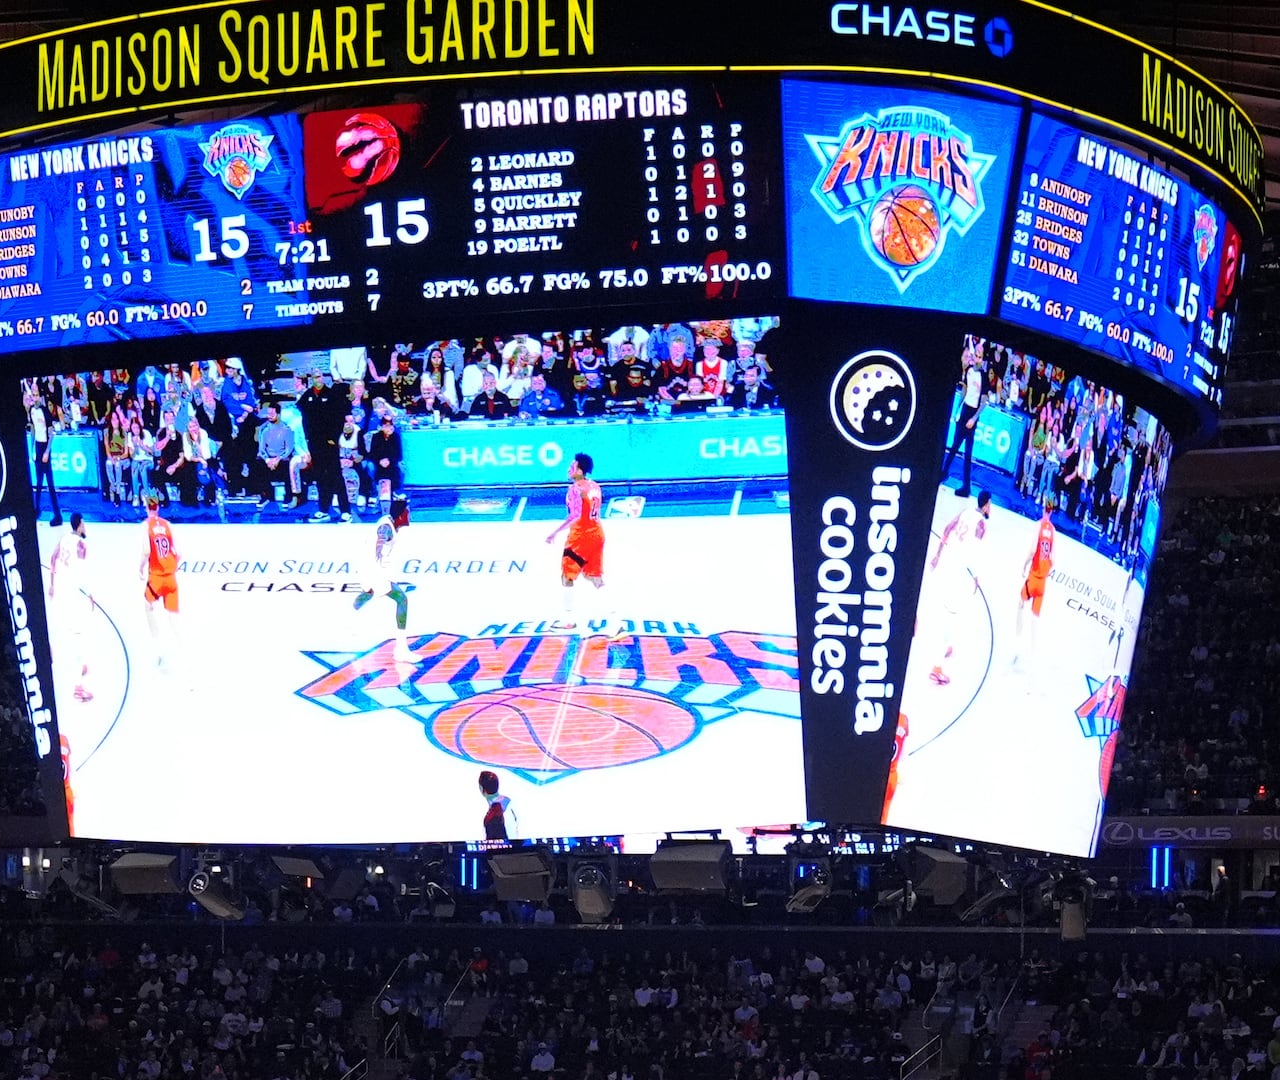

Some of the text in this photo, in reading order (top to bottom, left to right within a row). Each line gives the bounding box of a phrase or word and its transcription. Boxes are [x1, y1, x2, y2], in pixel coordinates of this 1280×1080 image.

[830, 3, 976, 47] CHASE
[37, 0, 595, 113] MADISON SQUARE GARDEN
[460, 88, 688, 130] TORONTO RAPTORS
[880, 112, 946, 134] NEW YORK
[1142, 52, 1224, 165] MADISON
[10, 137, 153, 182] NEW YORK KNICKS
[471, 151, 575, 172] 2 LEONARD
[820, 125, 978, 209] KNICKS
[1077, 136, 1179, 207] NEW YORK KNICKS
[472, 172, 563, 192] 4 BARNES
[474, 191, 582, 214] 5 QUICKLEY
[192, 213, 250, 262] 15
[288, 219, 312, 234] 1st
[364, 198, 429, 247] 15
[474, 213, 578, 234] 9 BARRETT
[274, 239, 331, 265] 7:21
[467, 235, 563, 256] 19 POELTL
[240, 268, 379, 295] 2 TEAM FOULS 2
[422, 261, 771, 299] 3PT% 66.7 FG% 75.0 FT% 100.0
[242, 294, 381, 320] 7 TIMEOUTS 7
[1175, 277, 1201, 322] 15
[16, 317, 44, 335] 66.7
[51, 313, 81, 330] FG%
[86, 308, 119, 327] 60.0
[124, 305, 158, 323] FT%
[161, 300, 207, 320] 100.0
[443, 444, 534, 468] CHASE
[402, 559, 527, 574] GARDEN
[810, 495, 861, 694] cookies
[854, 466, 910, 735] insomnia
[1138, 827, 1232, 842] LEXUS
